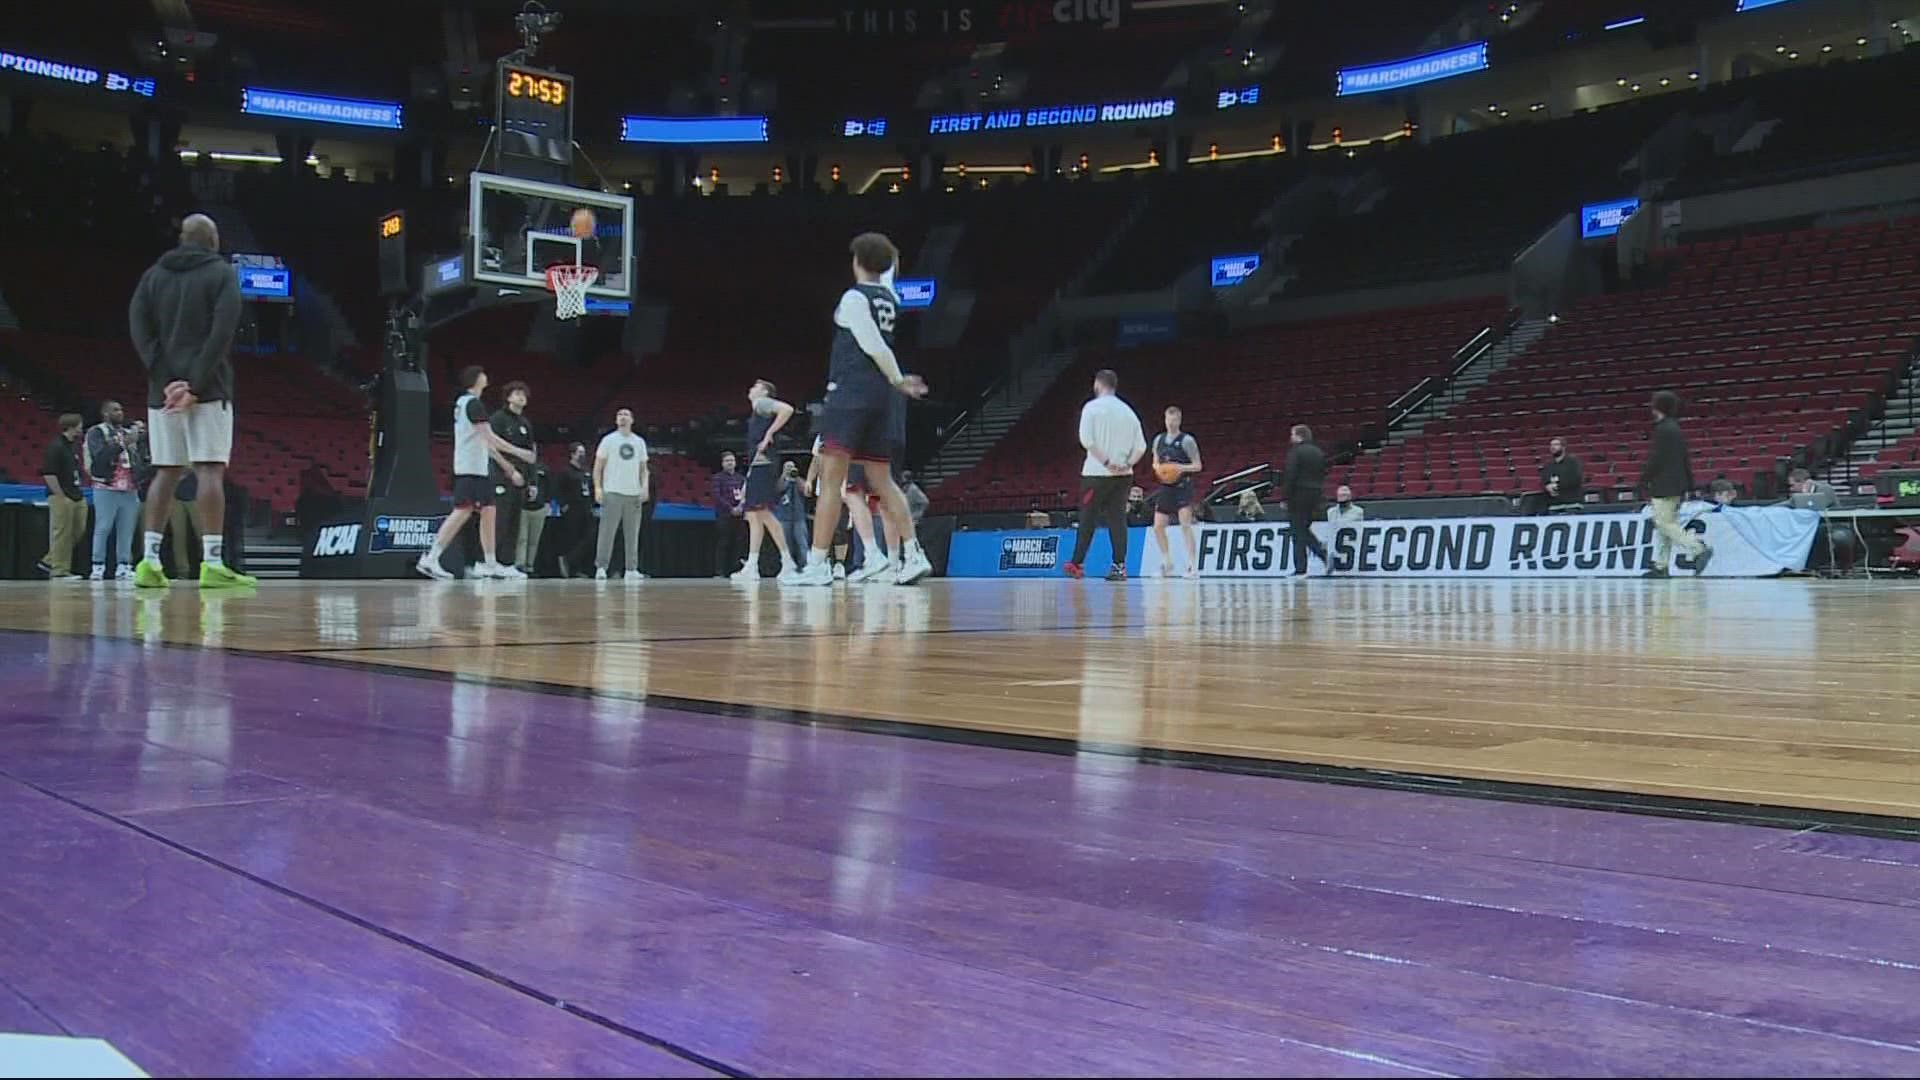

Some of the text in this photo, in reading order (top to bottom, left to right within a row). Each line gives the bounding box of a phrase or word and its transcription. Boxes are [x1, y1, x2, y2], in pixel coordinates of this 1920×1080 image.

[843, 9, 917, 32] THIS
[942, 8, 972, 31] IS
[0, 52, 99, 84] PIONSHIP
[1346, 51, 1478, 87] #MARCHMADNESS
[509, 72, 563, 105] 27:53
[252, 95, 392, 122] #MARCHMADNESS
[930, 99, 1175, 133] FIRST AND SECOND ROUNDS
[313, 524, 362, 556] NCAA
[388, 519, 430, 532] MARCH
[393, 533, 437, 545] MADNE
[1012, 539, 1042, 552] MARCH
[1015, 552, 1056, 565] MADNESS
[1198, 528, 1295, 570] FIRST
[1333, 524, 1495, 571] SECOND
